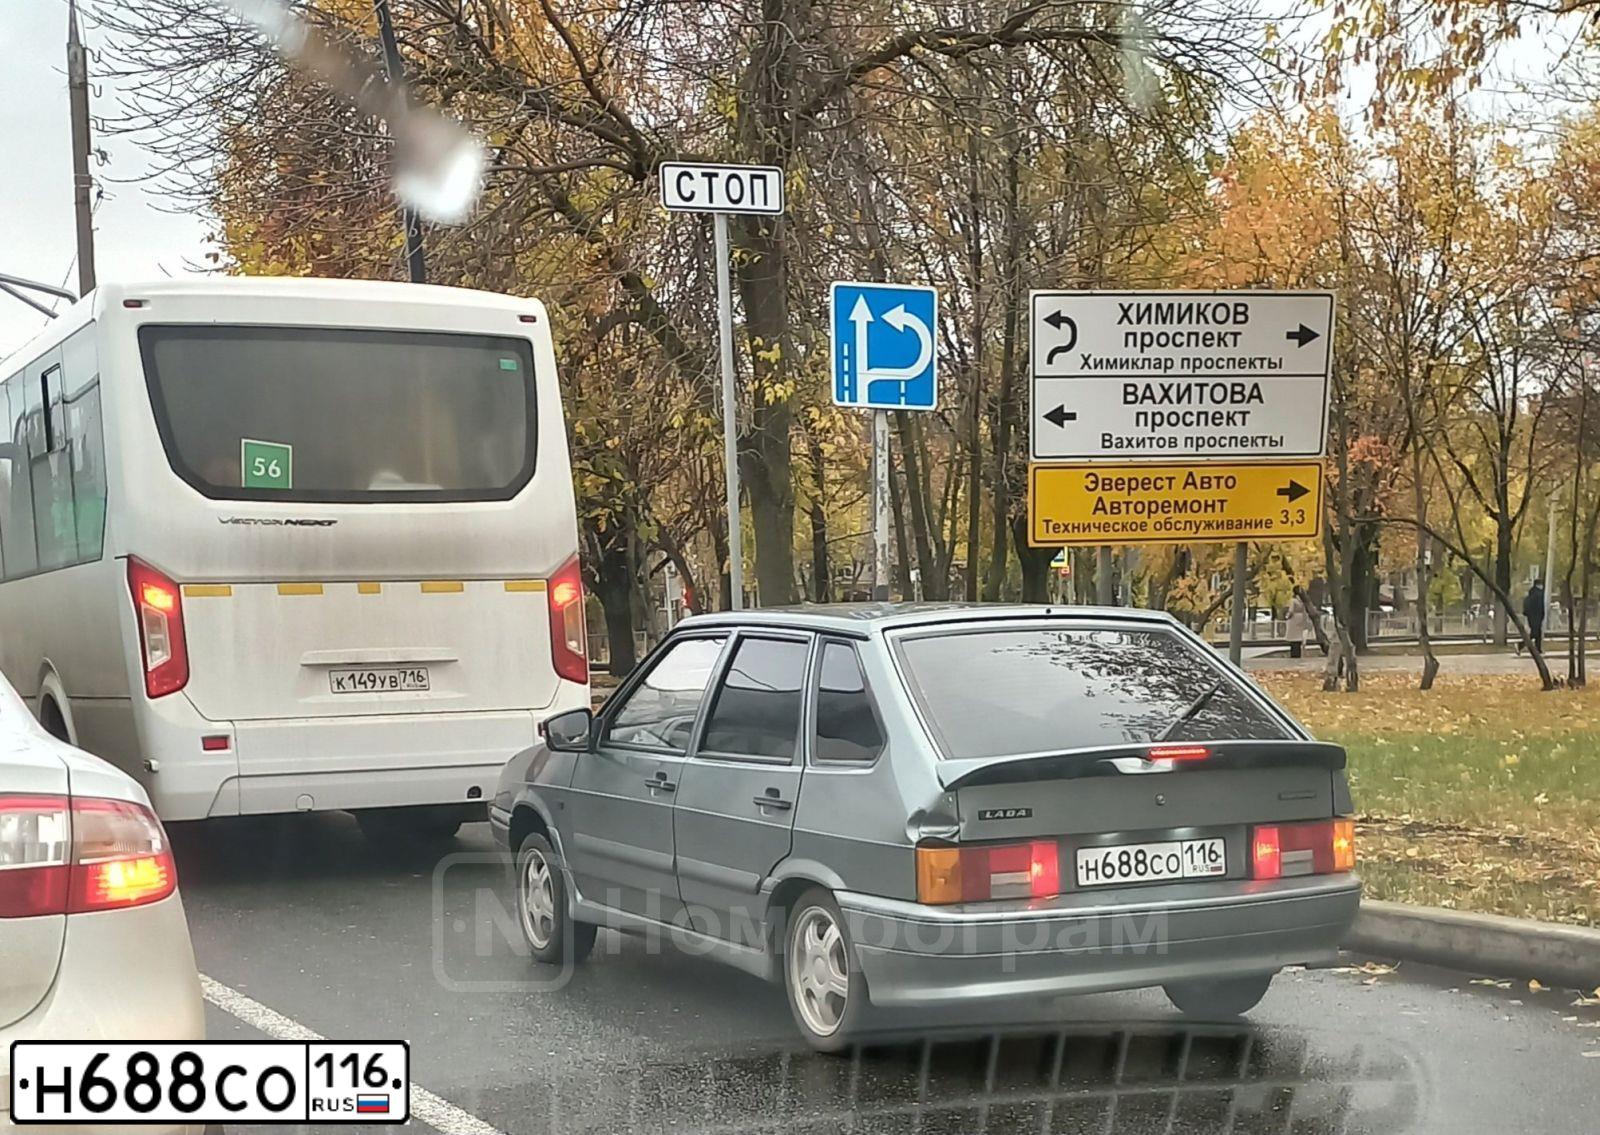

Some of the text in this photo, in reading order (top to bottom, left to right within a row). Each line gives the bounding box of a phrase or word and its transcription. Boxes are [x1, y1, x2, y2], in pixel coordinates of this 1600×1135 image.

[676, 170, 768, 206] СТОП
[1117, 302, 1249, 325] ХИМИКОВ
[1124, 330, 1242, 353] проспект
[1080, 354, 1283, 373] Химиклар проспекты
[1122, 382, 1264, 405] ВАХИТОВА
[1135, 410, 1250, 432] проспект
[1101, 433, 1284, 451] Вахитов проспекты
[252, 457, 281, 478] 56
[1084, 471, 1236, 495] Эверест Авто
[1092, 496, 1228, 518] Авторемонт
[1280, 509, 1306, 527] 3,3
[1043, 516, 1273, 534] Техническое обслуживание
[985, 809, 1026, 818] LADA
[1185, 842, 1218, 865] 116
